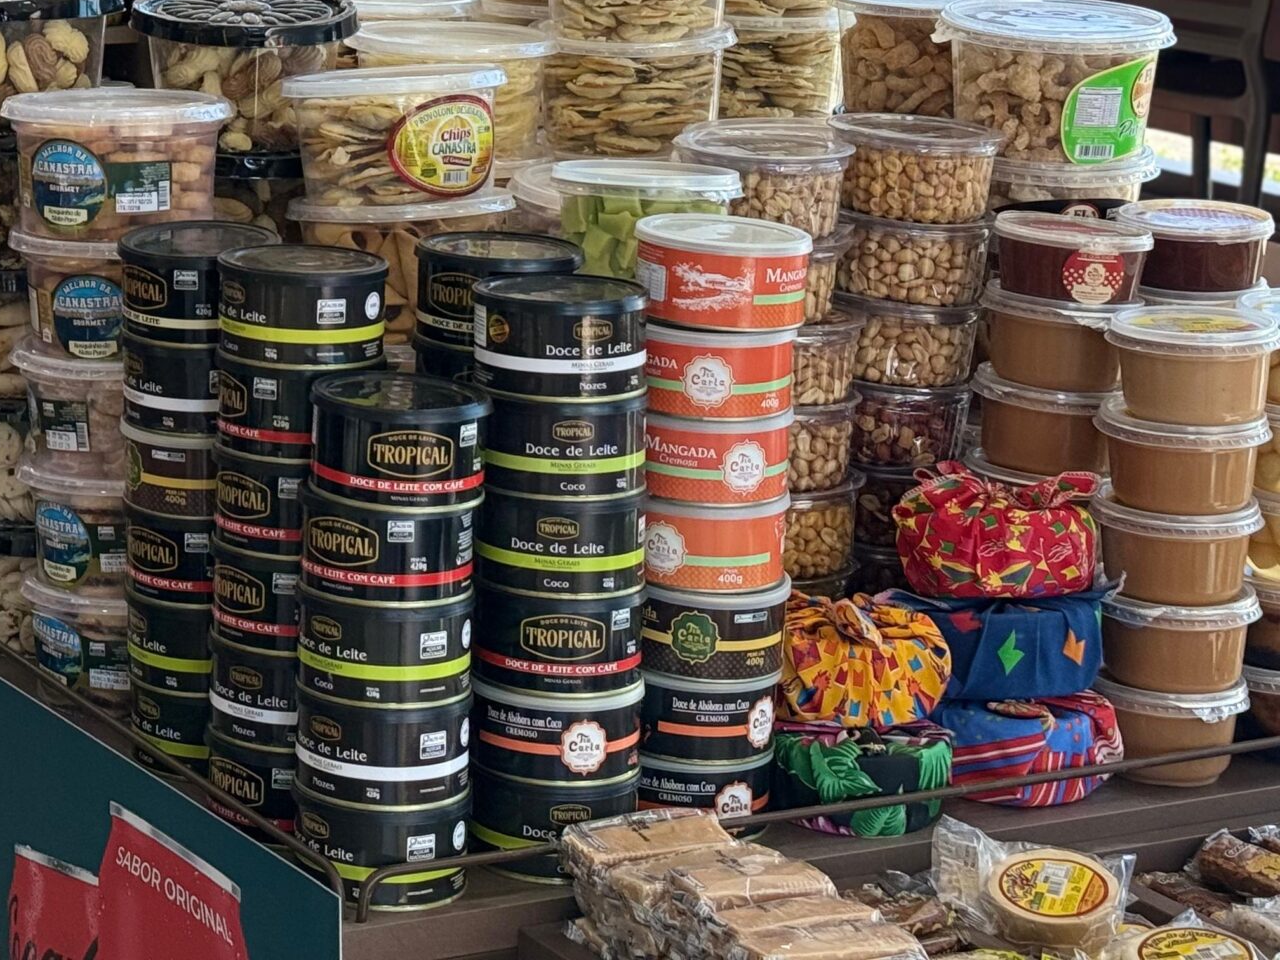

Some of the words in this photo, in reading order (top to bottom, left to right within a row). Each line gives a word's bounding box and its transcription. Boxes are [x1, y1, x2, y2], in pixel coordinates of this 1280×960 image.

[415, 106, 454, 128] PROVOLONE
[441, 127, 471, 142] Chips
[42, 144, 73, 158] MELHOR
[76, 151, 87, 162] DA
[432, 142, 476, 156] CANASTRA
[38, 161, 94, 175] CANASTRA
[63, 280, 96, 294] MELHOR
[99, 283, 111, 294] DA
[60, 296, 119, 307] CANASTRA
[141, 314, 160, 325] LEITE
[227, 307, 237, 318] de
[240, 308, 267, 323] Leite
[431, 317, 451, 329] DOCE
[452, 321, 464, 331] DE
[575, 324, 611, 338] TROPICAL
[546, 345, 580, 357] Doce
[586, 344, 603, 356] de
[608, 341, 632, 354] Leite
[700, 366, 715, 378] Tia
[127, 375, 137, 387] de
[139, 379, 163, 394] Leite
[579, 381, 607, 390] Nozes
[691, 374, 725, 386] Carla
[760, 397, 779, 409] 400g
[240, 426, 260, 438] CAFÉ
[555, 426, 592, 438] TROPICAL
[526, 443, 560, 456] Doce
[566, 447, 583, 456] de
[589, 444, 618, 456] Leite
[646, 433, 717, 459] MANGADA
[374, 443, 449, 465] TROPICAL
[659, 454, 698, 468] Cremosa
[738, 453, 752, 464] Tia
[730, 461, 760, 473] Carla
[350, 476, 375, 489] DOCE
[377, 480, 392, 490] DE
[394, 482, 420, 491] LEITE
[423, 482, 442, 491] COM
[444, 480, 464, 489] CAFÉ
[560, 482, 586, 491] Coco
[165, 495, 186, 506] 400g
[38, 514, 80, 535] CANASTRA
[224, 520, 241, 531] LEITE
[242, 525, 261, 536] COM
[262, 528, 286, 538] CAFÉ
[540, 523, 577, 534] TROPICAL
[311, 526, 374, 557] TROPICAL
[511, 537, 544, 553] Doce
[549, 542, 567, 554] de
[573, 542, 605, 554] Leite
[655, 532, 668, 546] Tia
[647, 539, 677, 555] Carla
[314, 565, 322, 575] DE
[323, 568, 345, 579] LEITE
[347, 573, 368, 583] COM
[370, 574, 396, 584] CAFÉ
[718, 573, 743, 584] 400g
[153, 577, 170, 589] COM
[171, 580, 193, 590] CAFÉ
[543, 578, 569, 588] Coco
[238, 619, 255, 630] COM
[257, 622, 280, 634] CAFÉ
[540, 618, 559, 626] DOCE
[570, 619, 588, 628] LEITE
[132, 633, 141, 644] de
[143, 637, 167, 653] Leite
[526, 626, 601, 649] TROPICAL
[678, 628, 711, 645] Carla
[318, 641, 331, 654] de
[336, 645, 368, 661] Leite
[505, 658, 530, 670] DOCE
[531, 664, 544, 672] DE
[547, 665, 573, 674] LEITE
[575, 665, 596, 674] COM
[597, 662, 618, 672] CAFÉ
[745, 657, 764, 668] 400g
[314, 677, 334, 690] Coco
[238, 691, 252, 704] de
[257, 694, 288, 708] Leite
[672, 697, 689, 710] Doce
[689, 699, 697, 710] de
[698, 700, 723, 711] Abóbora
[723, 702, 736, 711] com
[736, 700, 750, 710] Coco
[500, 709, 506, 720] de
[507, 711, 531, 726] Abóbora
[532, 718, 545, 728] com
[546, 717, 562, 729] Coco
[696, 715, 729, 723] CREMOSO
[141, 719, 153, 731] de
[155, 724, 181, 740] Leite
[232, 724, 256, 737] Nozes
[505, 727, 538, 739] CREMOSO
[576, 733, 591, 743] Tia
[318, 741, 331, 755] de
[336, 746, 368, 762] Leite
[568, 740, 600, 752] Carla
[312, 775, 335, 791] Nozes
[651, 777, 660, 788] de
[660, 778, 685, 791] Abóbora
[687, 783, 700, 792] com
[700, 781, 716, 792] Coco
[658, 793, 693, 803] CREMOSO
[728, 794, 741, 804] Tia
[552, 809, 589, 821] TROPICAL
[721, 802, 748, 814] Carla
[522, 825, 557, 839] Doce
[308, 841, 321, 853] de
[324, 844, 354, 862] Leite
[115, 846, 162, 892] SABOR
[164, 878, 234, 946] ORIGINAL
